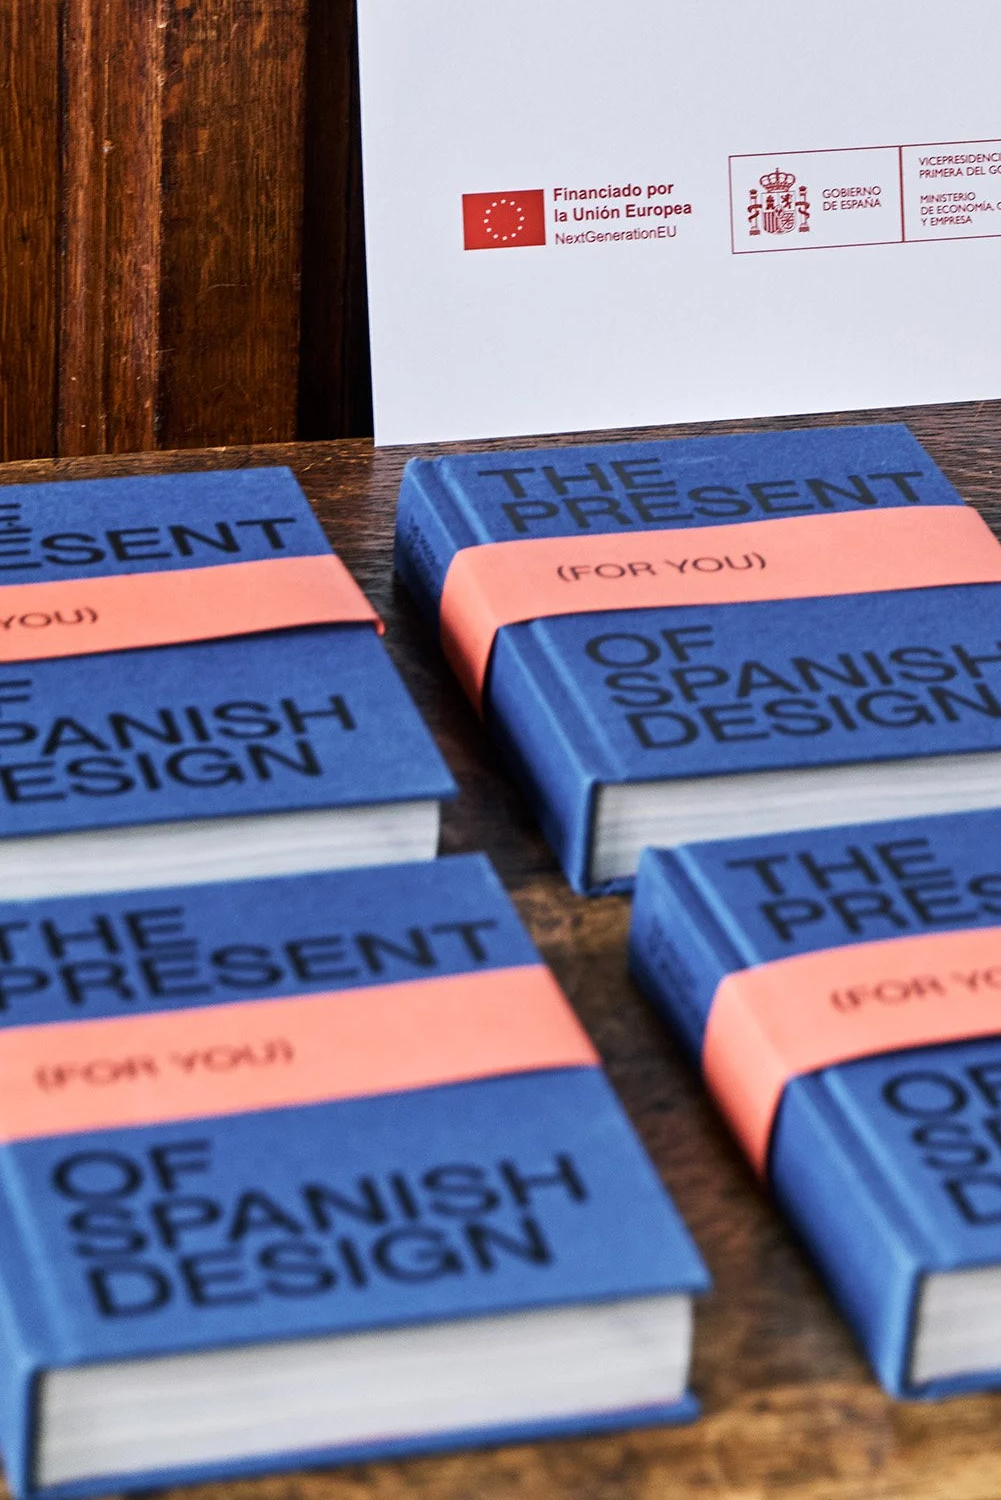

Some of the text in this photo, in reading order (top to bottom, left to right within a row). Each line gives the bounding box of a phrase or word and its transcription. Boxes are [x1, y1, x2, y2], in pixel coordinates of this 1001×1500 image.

[919, 166, 963, 179] PRIMERA
[966, 165, 986, 176] DEL
[553, 182, 674, 201] Financiado por
[822, 185, 881, 199] GOBIERNO
[823, 196, 881, 211] DE ESPAÑA
[920, 191, 976, 204] MINISTERIO
[554, 202, 692, 223] la Unión Europea
[921, 204, 935, 215] DE
[921, 215, 972, 226] Y EMPRESA
[555, 226, 677, 245] NextGenerationEU
[478, 457, 662, 498] THE
[503, 471, 923, 534] PRESENT
[556, 552, 767, 584] (FOR YOU)
[585, 625, 715, 669] OF
[728, 837, 940, 897] THE
[0, 906, 187, 963] THE
[0, 920, 498, 1012] PRESENT
[831, 974, 942, 1013] (FOR
[52, 1139, 212, 1202] OF
[67, 1151, 590, 1260] SPANISH
[86, 1217, 555, 1320] DESIGN
